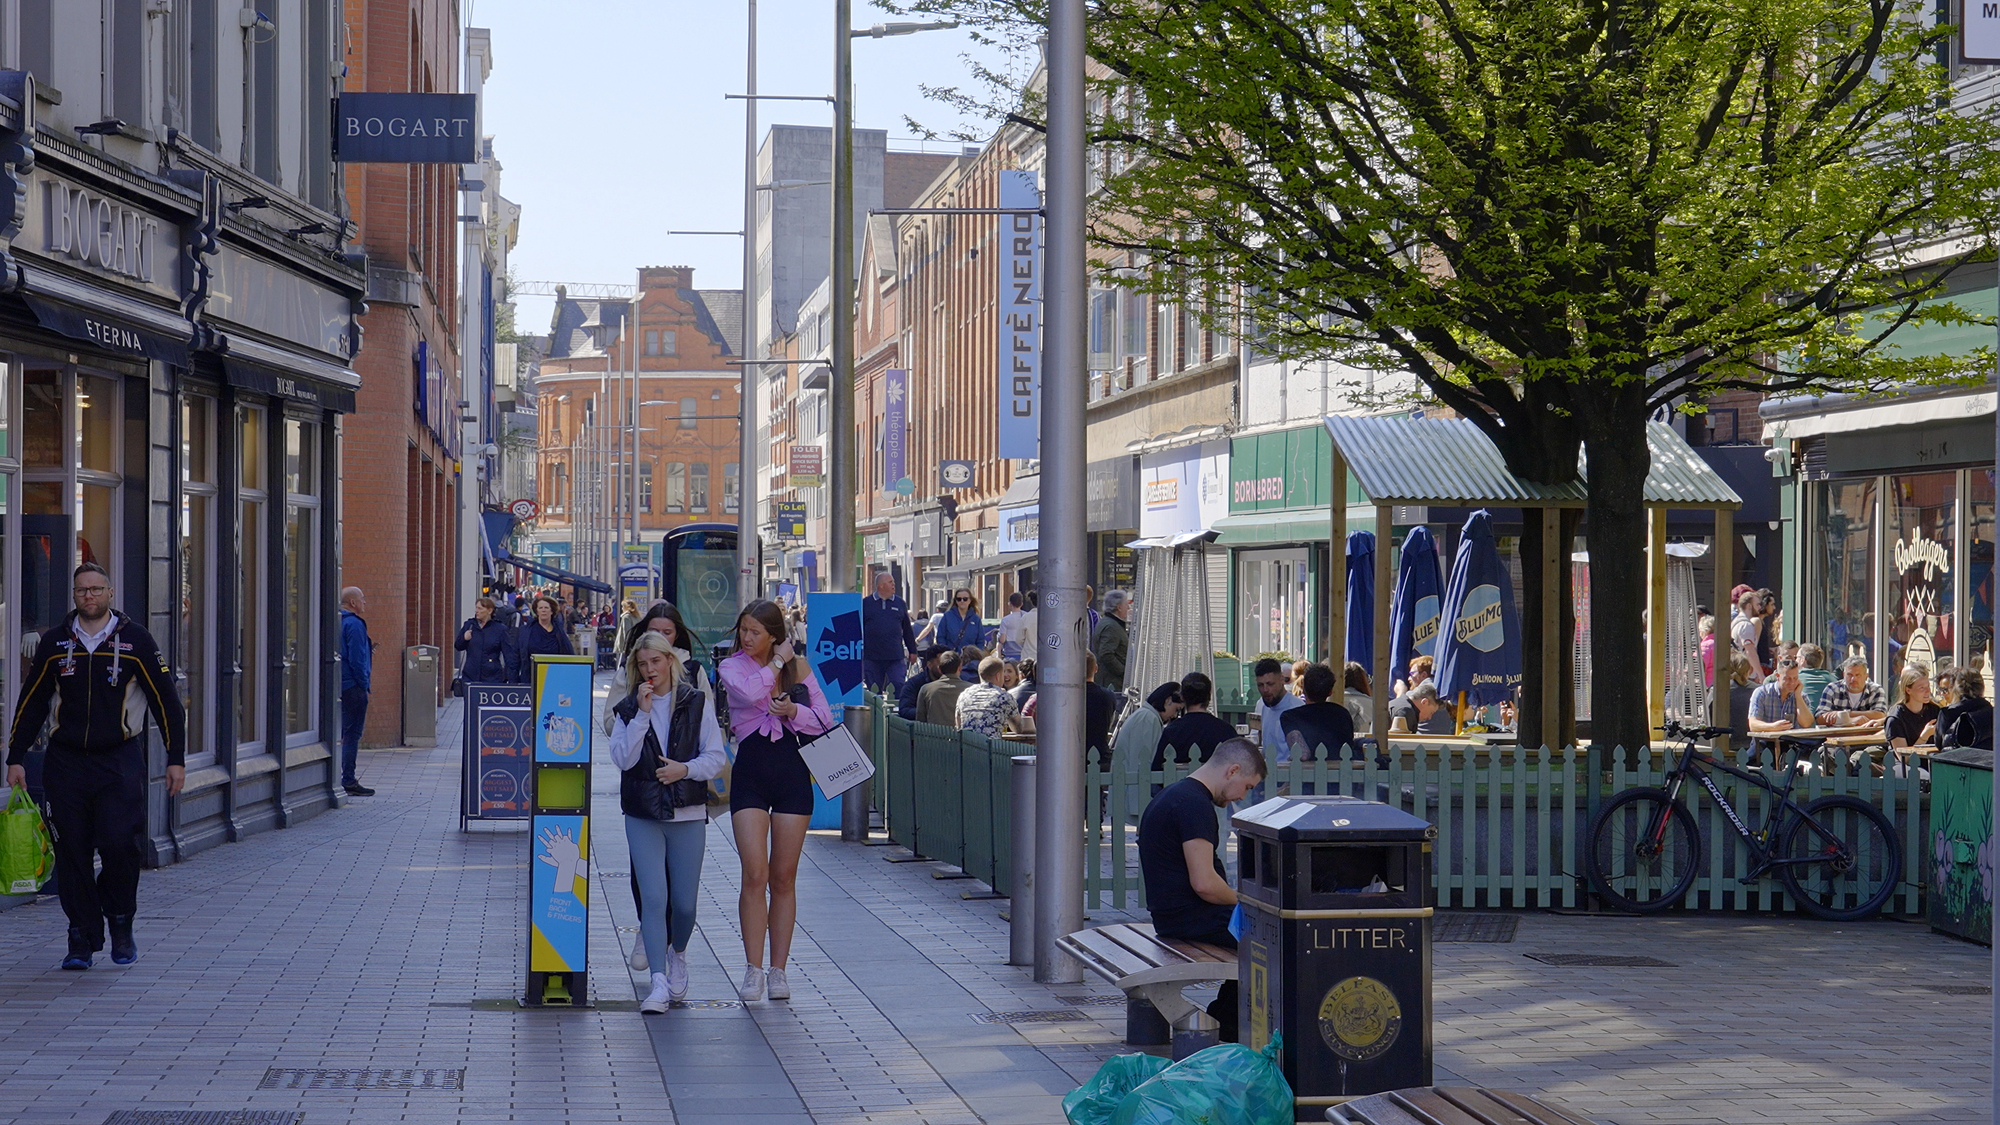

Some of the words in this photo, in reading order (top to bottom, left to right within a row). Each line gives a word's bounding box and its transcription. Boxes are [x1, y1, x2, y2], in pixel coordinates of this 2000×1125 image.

[346, 117, 469, 137] BOGART
[50, 180, 158, 283] BOGART
[1013, 213, 1033, 305] NERO
[85, 318, 142, 351] ETERNA
[890, 411, 903, 459] thérapie
[779, 503, 790, 511] To
[792, 503, 805, 511] Let
[705, 536, 723, 544] pulse
[1894, 526, 1949, 582] Bootleggers
[1485, 605, 1501, 622] MO
[1414, 622, 1433, 642] LUE
[820, 639, 863, 661] Belf
[479, 692, 532, 705] BOGA
[829, 702, 845, 710] ASE
[828, 761, 860, 782] DUNNES
[1701, 776, 1749, 836] ROCKRIDER
[550, 898, 572, 907] FRONT
[554, 913, 582, 923] FINGERS
[1314, 928, 1406, 949] LITTER
[1324, 979, 1399, 1016] BELFAST
[1323, 1023, 1347, 1050] CITY
[1346, 1023, 1398, 1057] COUNCIL
